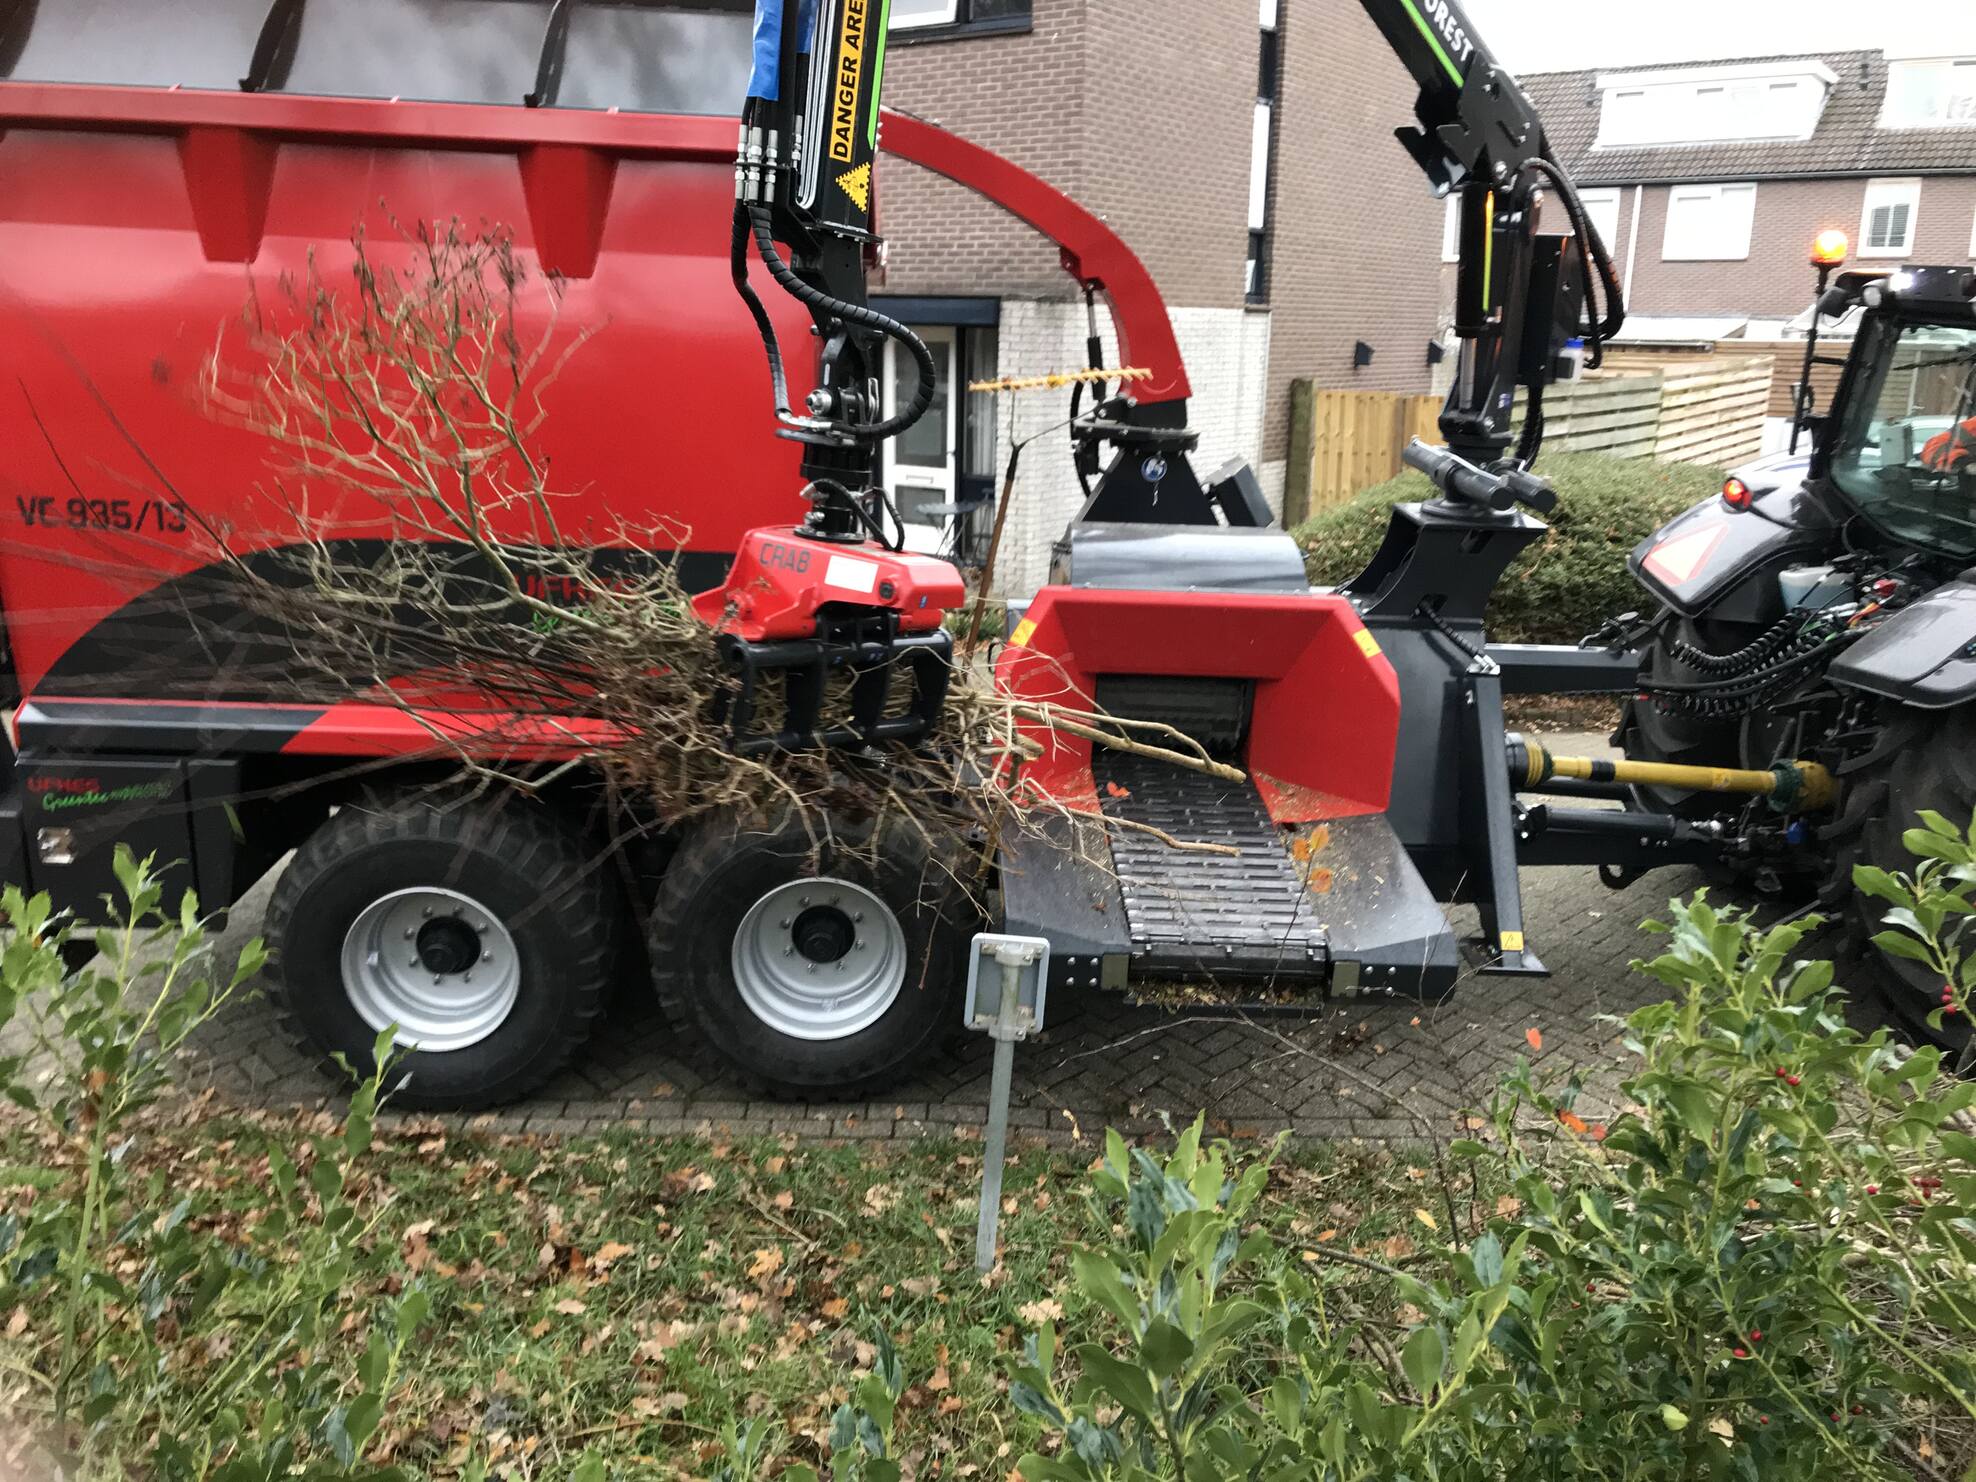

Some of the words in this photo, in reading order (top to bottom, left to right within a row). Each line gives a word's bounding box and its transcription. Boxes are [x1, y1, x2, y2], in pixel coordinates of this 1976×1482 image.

[845, 0, 868, 51] ARE
[834, 56, 857, 158] DANGER
[759, 542, 811, 574] CRAB
